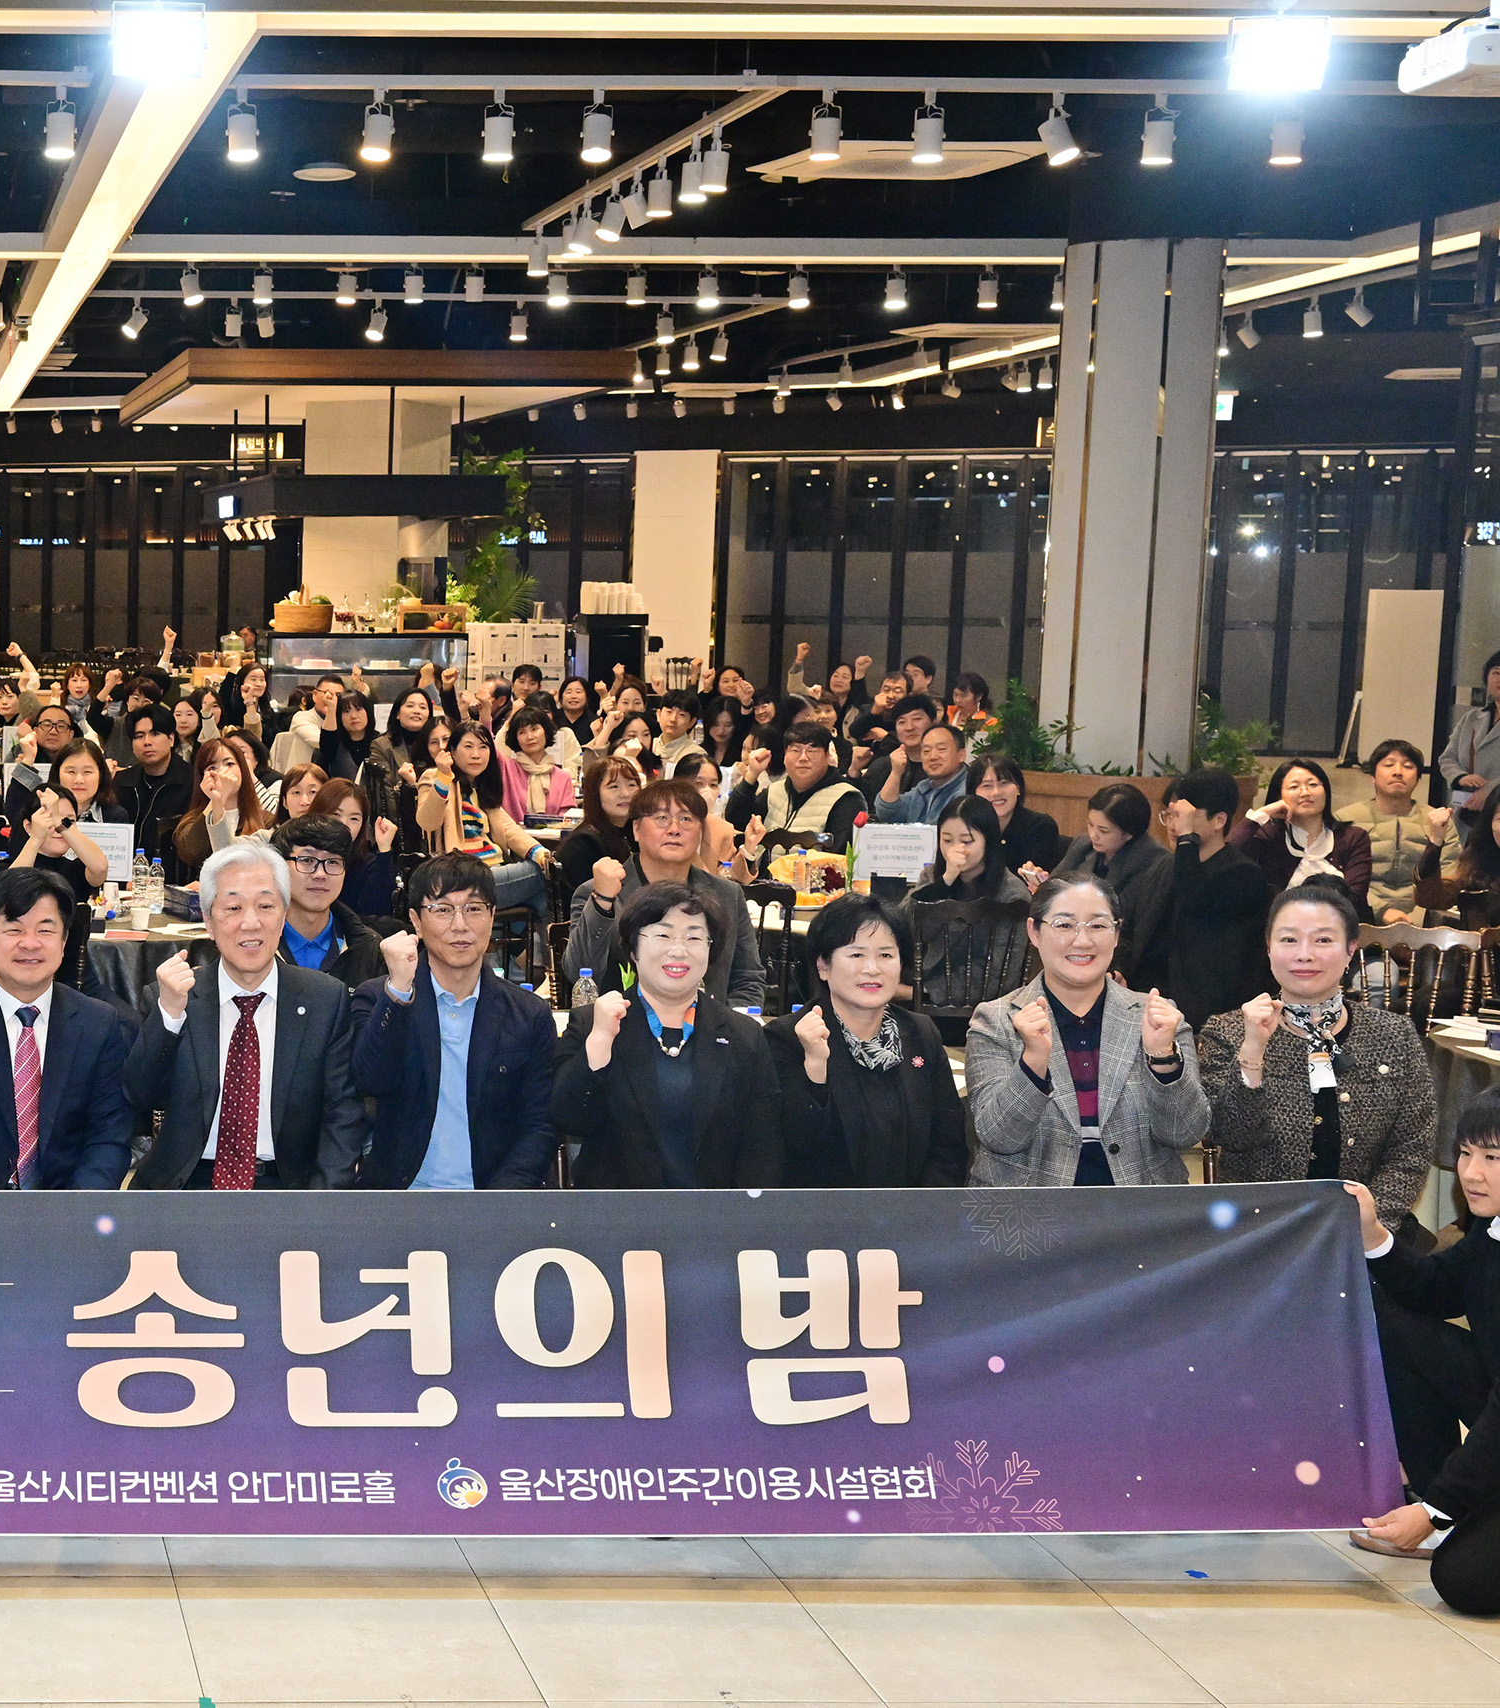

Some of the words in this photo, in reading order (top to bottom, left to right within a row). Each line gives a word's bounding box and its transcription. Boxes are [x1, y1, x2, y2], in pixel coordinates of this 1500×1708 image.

[67, 1248, 671, 1427] 송년의
[738, 1249, 922, 1424] 밤
[228, 1470, 396, 1504] 안다미로홀
[499, 1465, 937, 1502] 울산장애인주간이용시설협회
